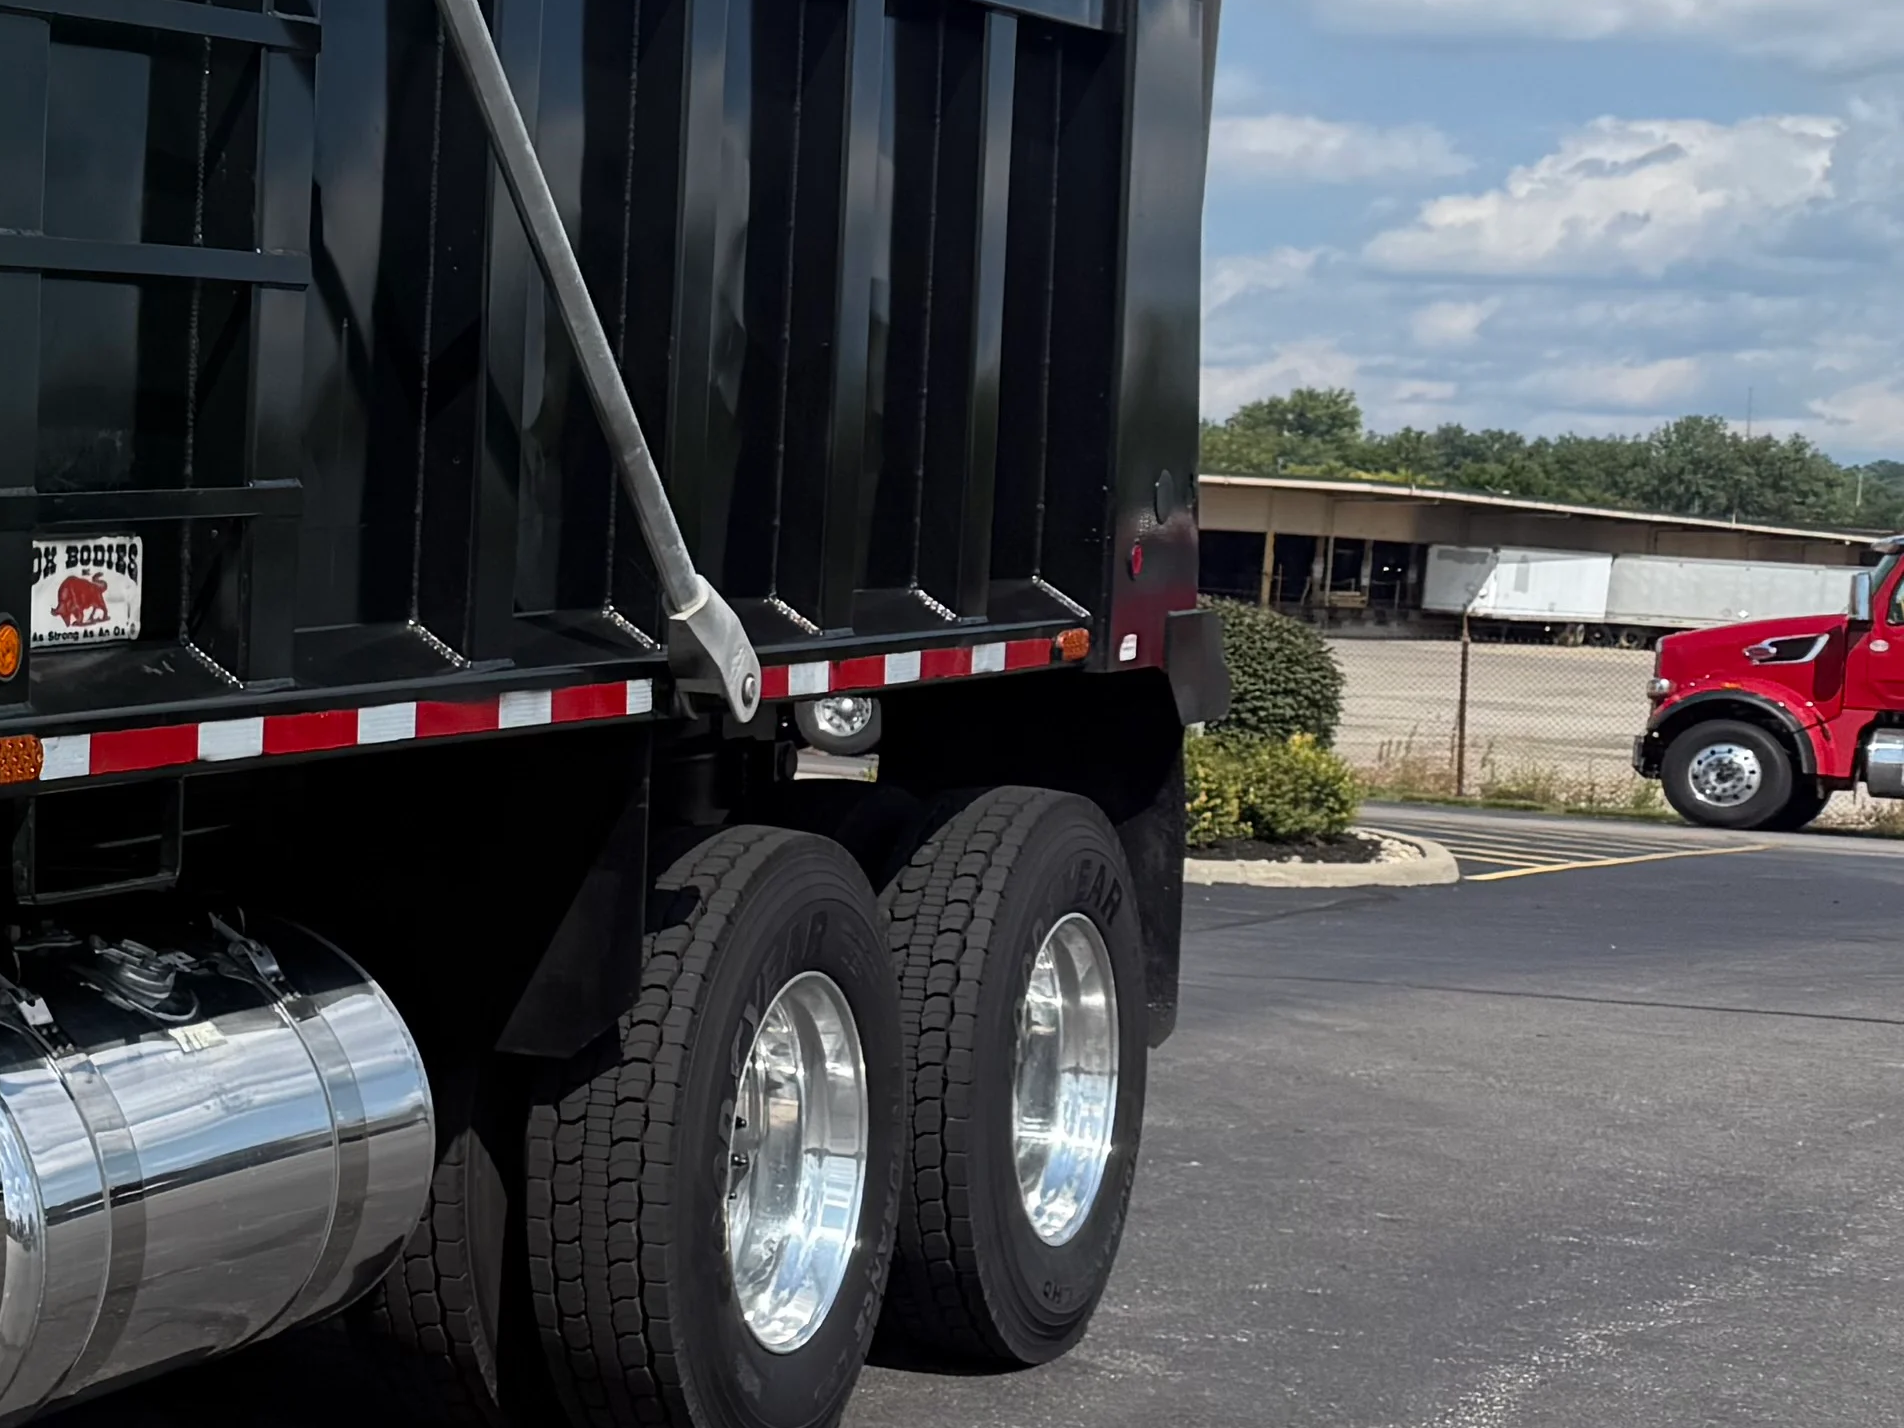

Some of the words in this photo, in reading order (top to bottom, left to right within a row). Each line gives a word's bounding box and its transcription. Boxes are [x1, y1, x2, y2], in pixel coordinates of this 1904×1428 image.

[65, 542, 139, 586] BODIES
[48, 630, 80, 642] Strong
[83, 629, 94, 639] As
[98, 627, 110, 638] An
